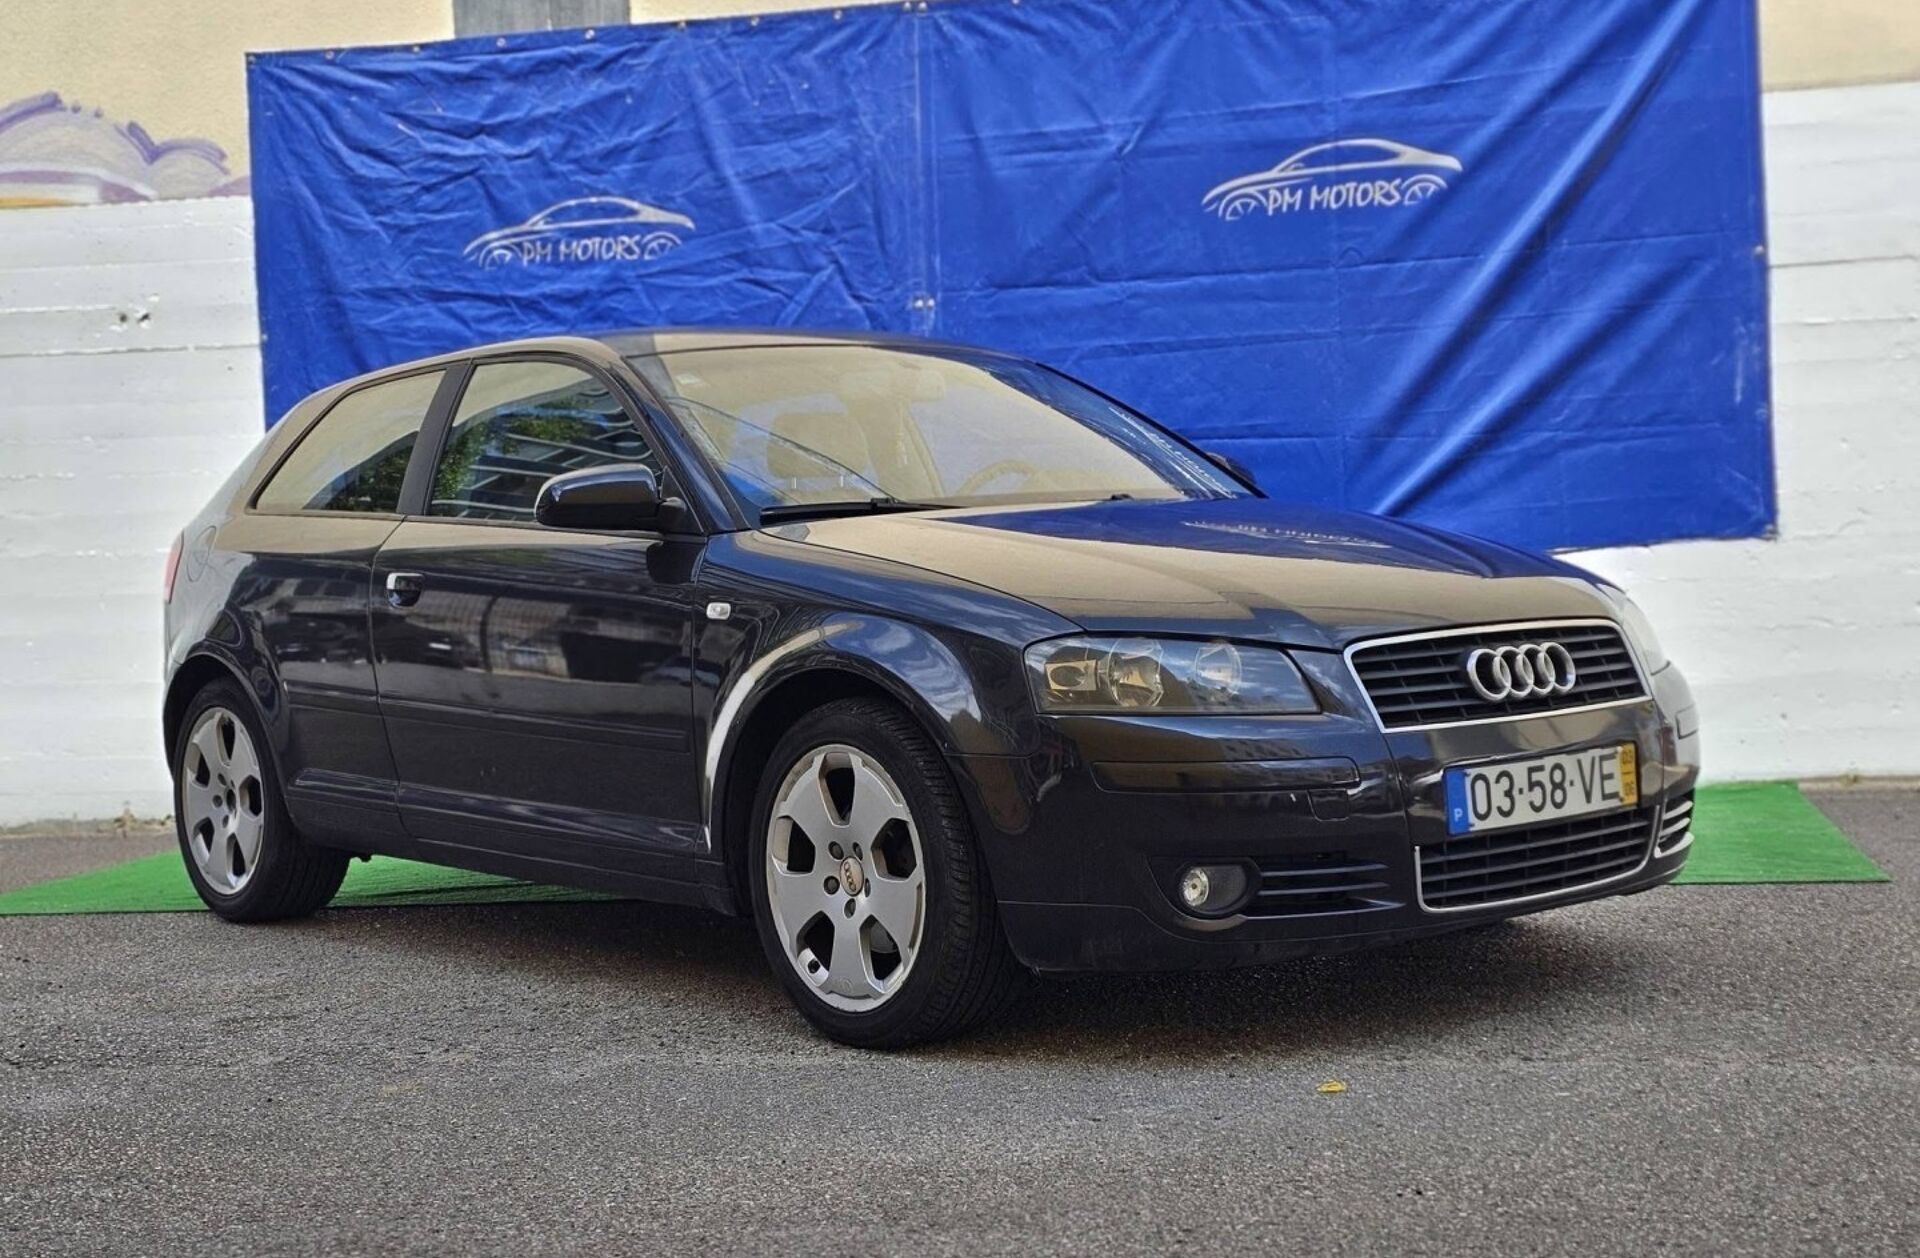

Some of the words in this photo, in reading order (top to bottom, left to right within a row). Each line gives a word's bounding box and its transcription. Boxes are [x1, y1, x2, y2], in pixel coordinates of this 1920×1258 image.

[1268, 186, 1301, 216] PM
[1310, 178, 1402, 210] MOTORS
[523, 240, 550, 267] PM
[560, 234, 641, 262] MOTORS
[1454, 808, 1463, 822] P
